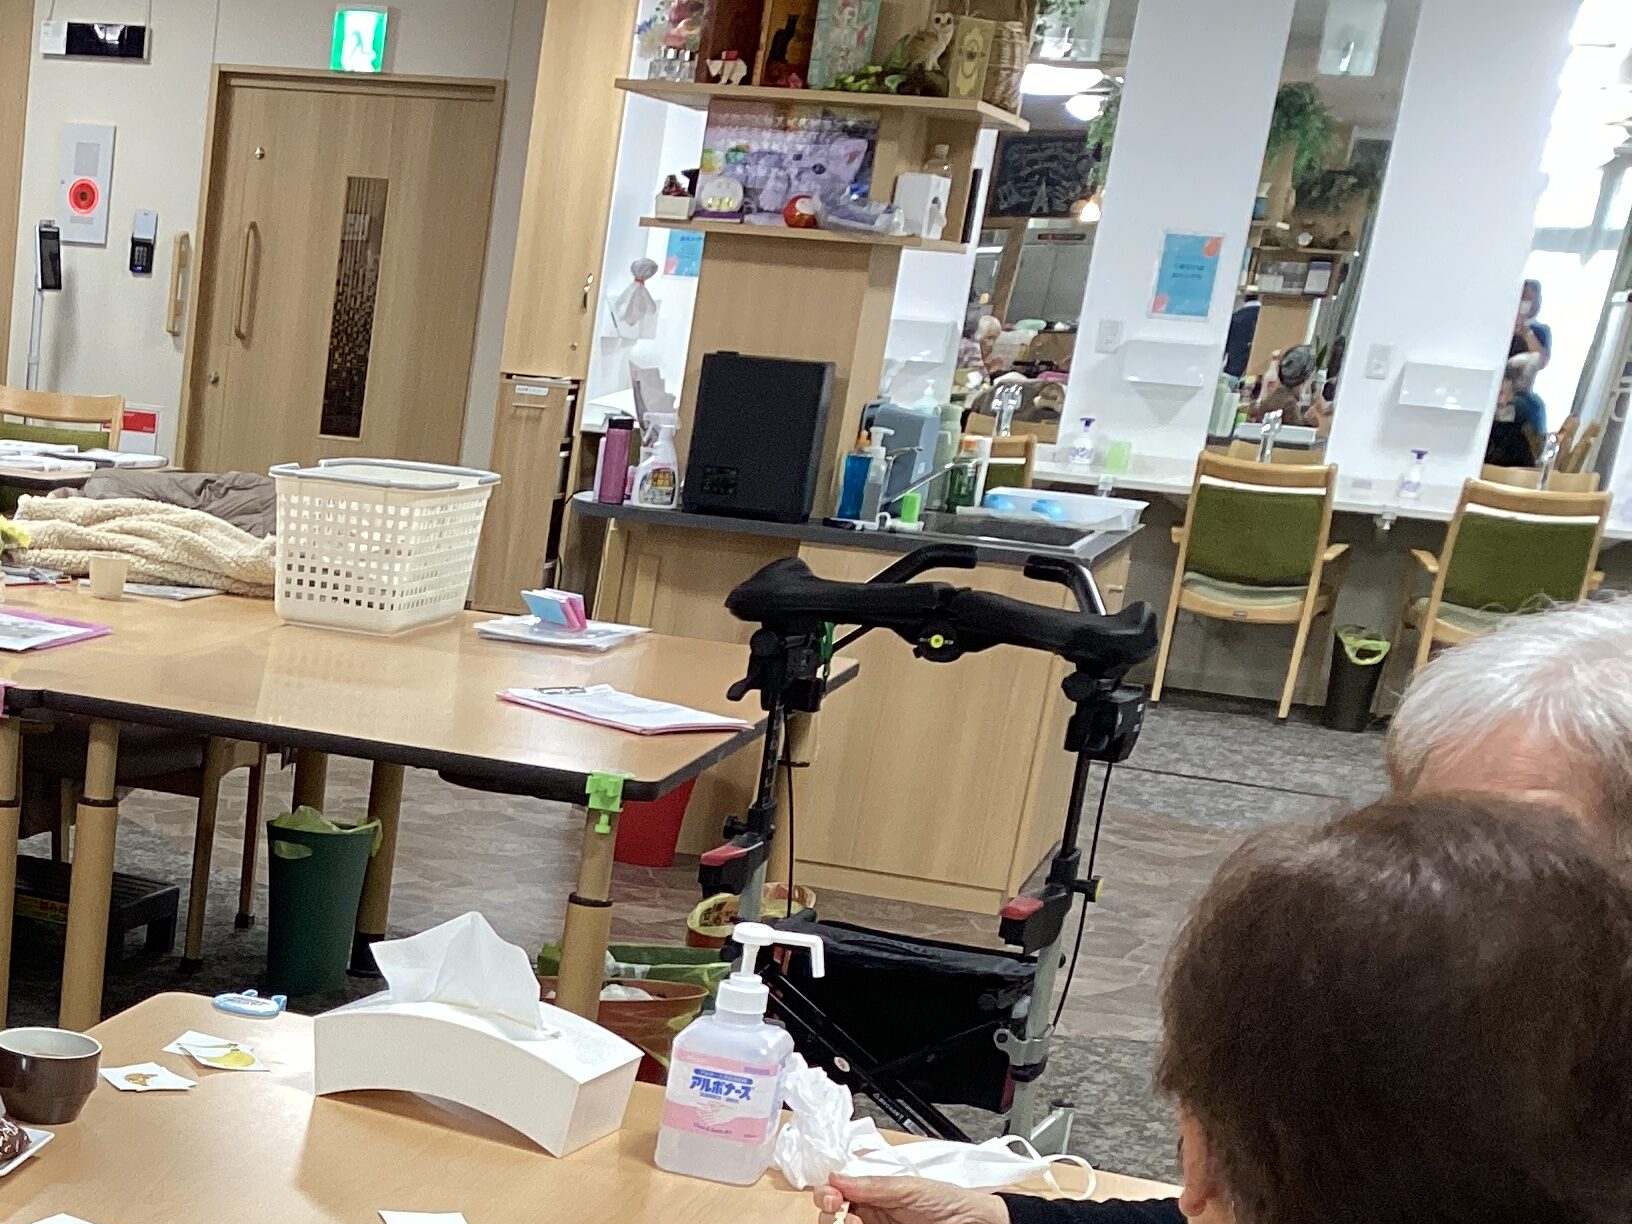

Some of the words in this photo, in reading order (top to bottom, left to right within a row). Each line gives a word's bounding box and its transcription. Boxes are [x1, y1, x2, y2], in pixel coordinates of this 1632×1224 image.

[689, 1075, 752, 1101] アルボナース
